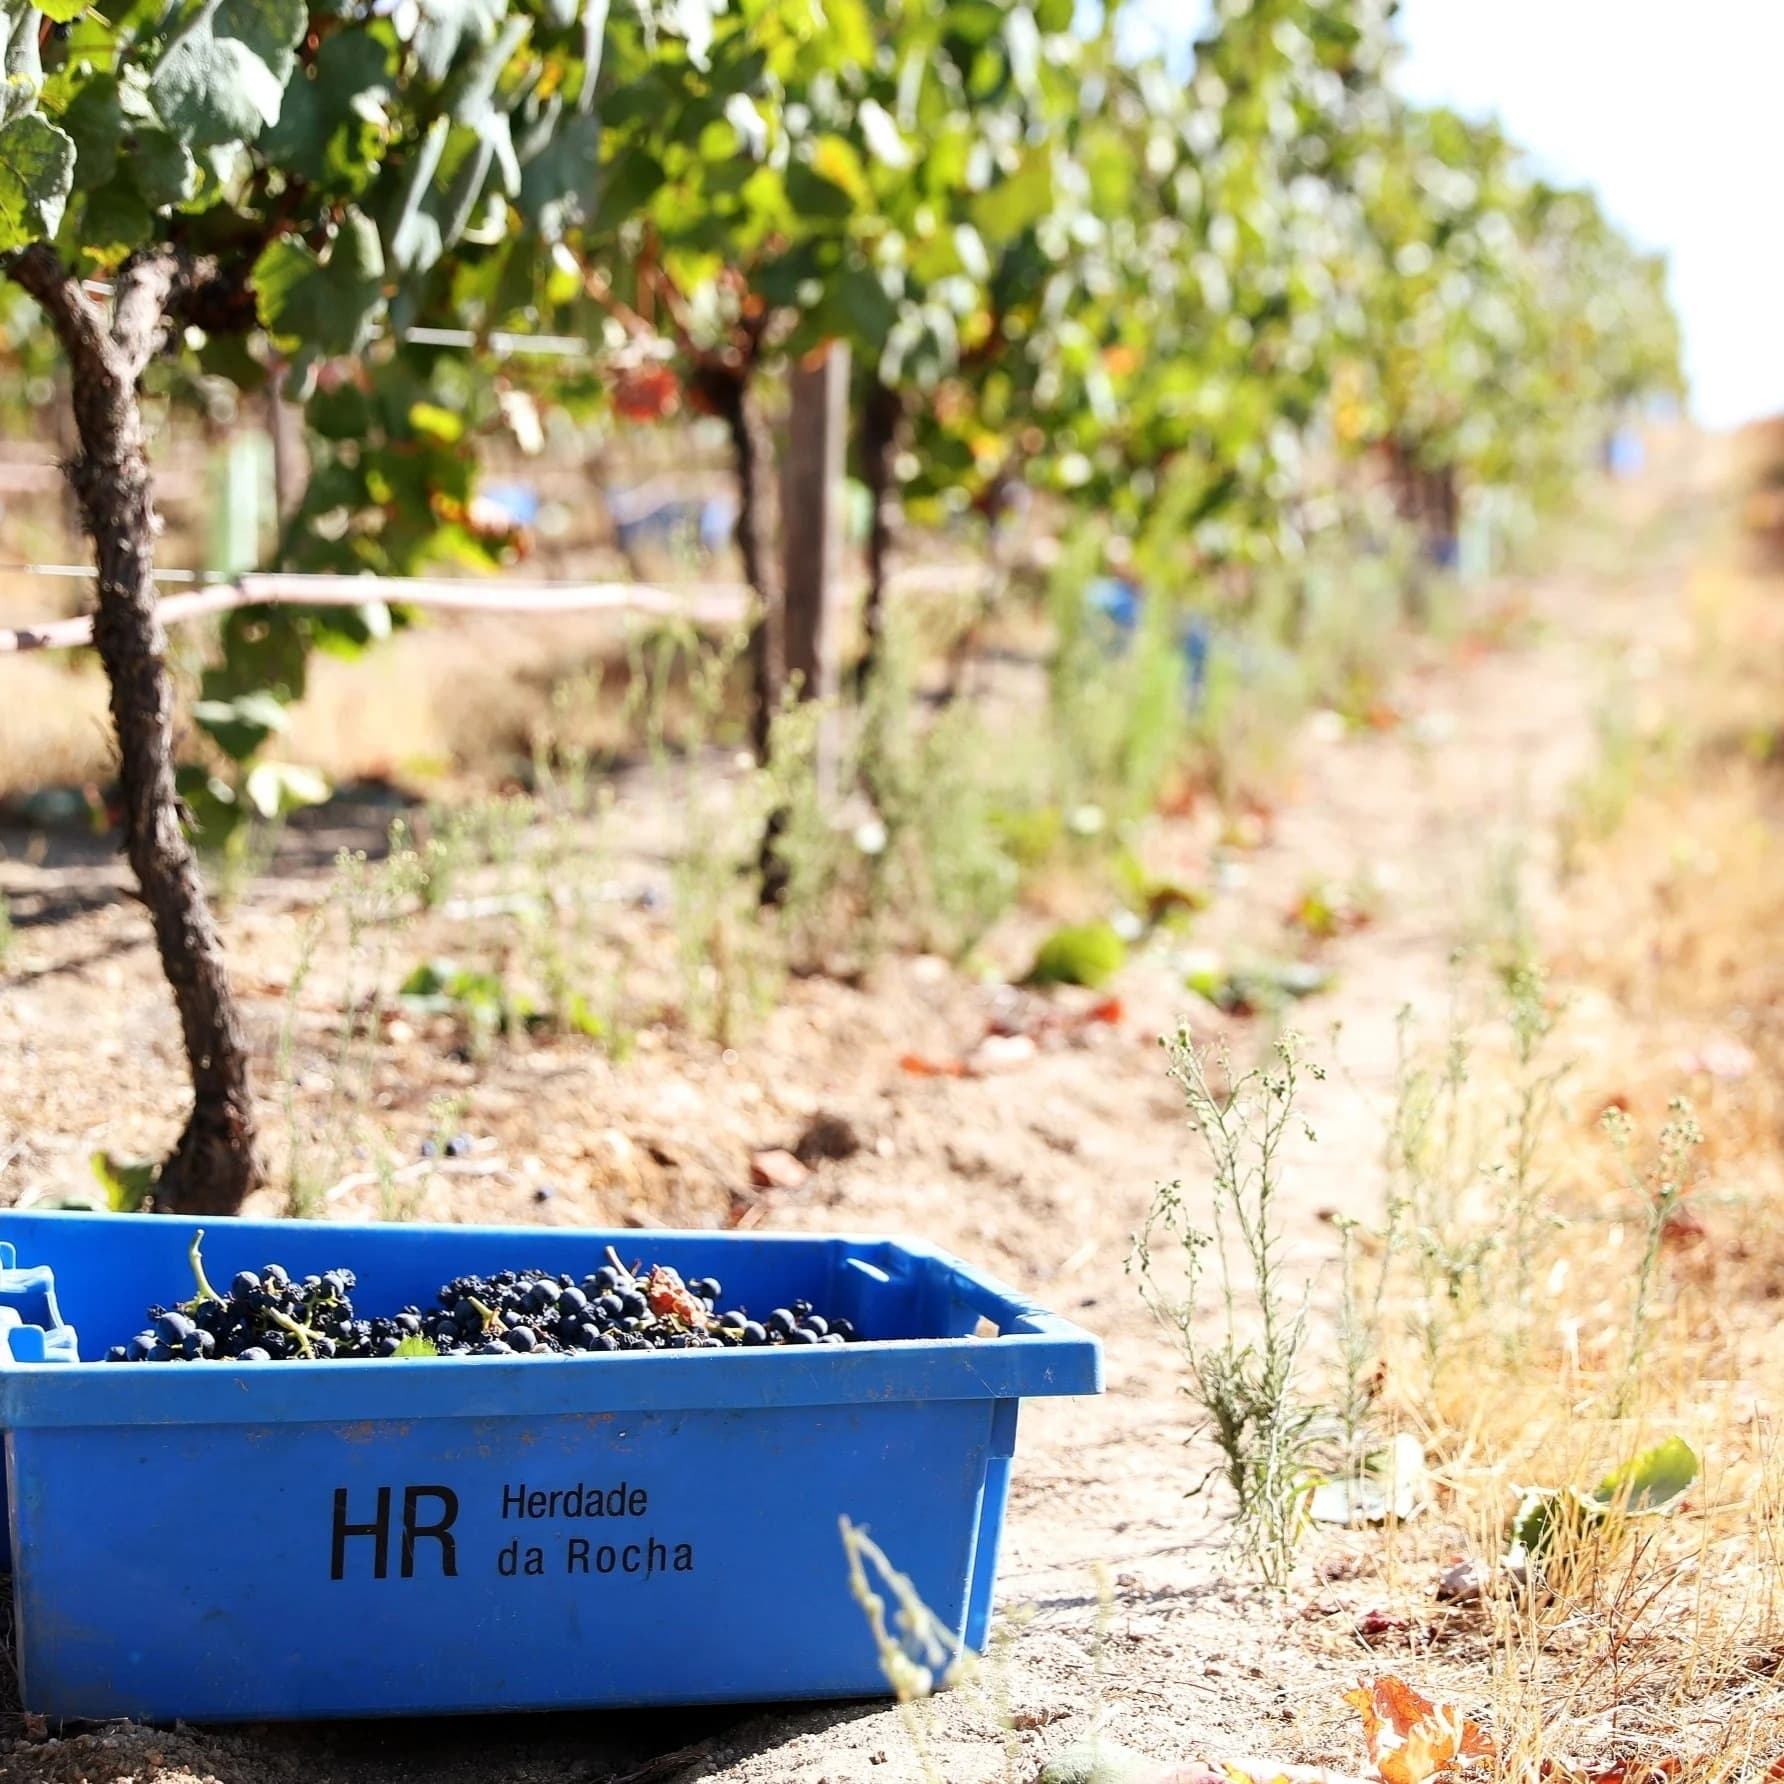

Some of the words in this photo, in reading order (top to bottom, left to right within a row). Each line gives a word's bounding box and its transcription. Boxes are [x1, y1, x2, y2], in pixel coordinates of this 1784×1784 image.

[501, 1482, 648, 1519] Herdade
[330, 1484, 459, 1581] HR
[497, 1540, 545, 1577] da
[567, 1537, 694, 1576] Rocha
